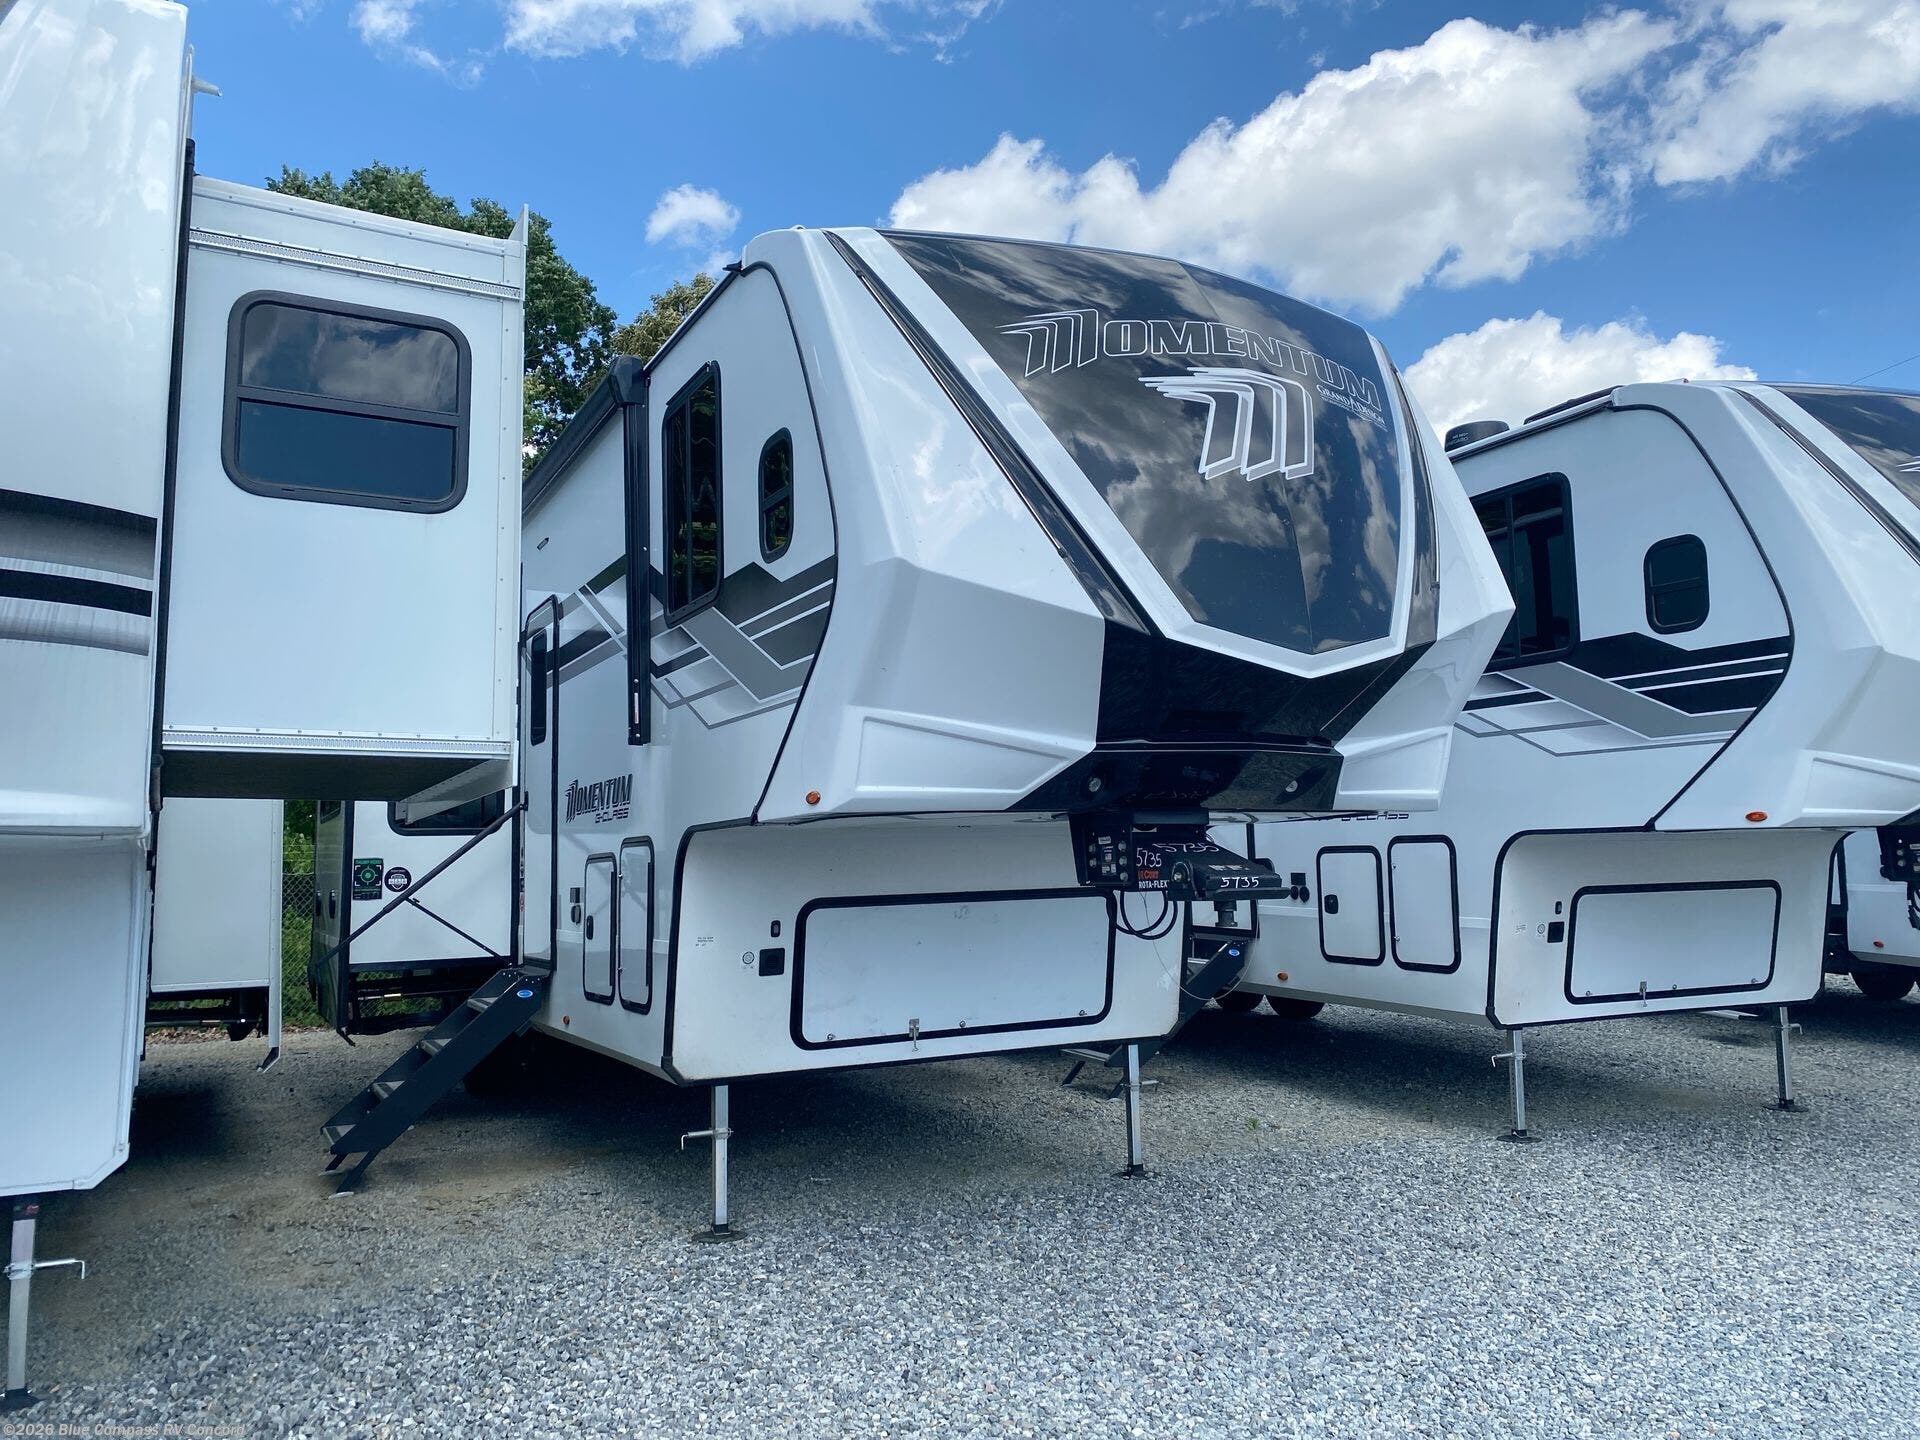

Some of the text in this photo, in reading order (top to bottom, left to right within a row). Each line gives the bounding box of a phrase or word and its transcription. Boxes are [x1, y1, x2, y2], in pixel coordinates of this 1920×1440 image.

[995, 308, 1382, 413] MOMENTUM
[565, 773, 633, 823] MOMENTUM
[1136, 847, 1162, 868] 5735
[1220, 876, 1259, 889] 5735
